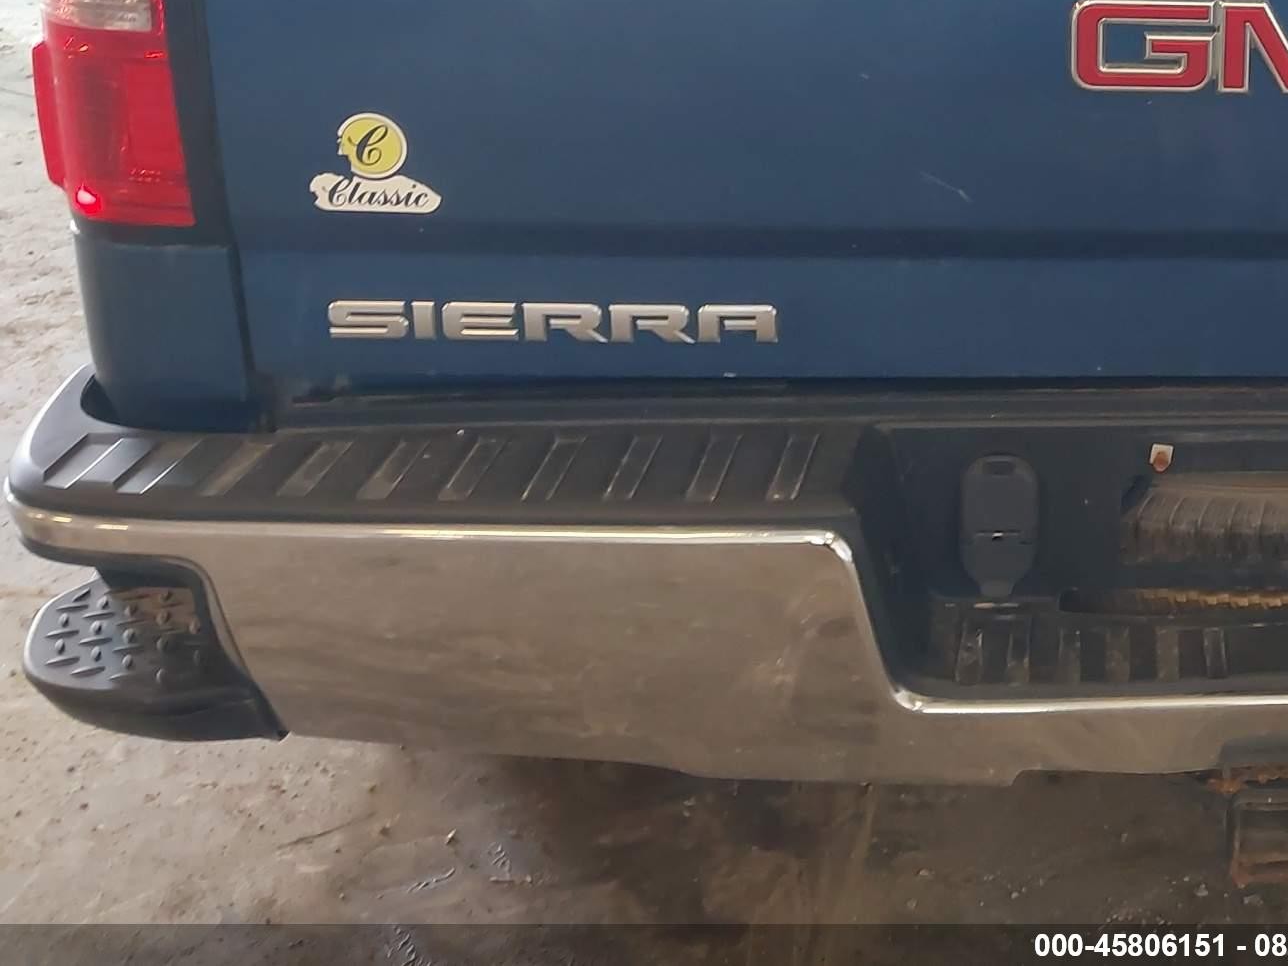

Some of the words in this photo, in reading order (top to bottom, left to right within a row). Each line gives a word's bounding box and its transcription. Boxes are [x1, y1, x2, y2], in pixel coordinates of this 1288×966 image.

[347, 124, 388, 166] C
[322, 177, 430, 208] Classic
[328, 300, 778, 343] SIERRA
